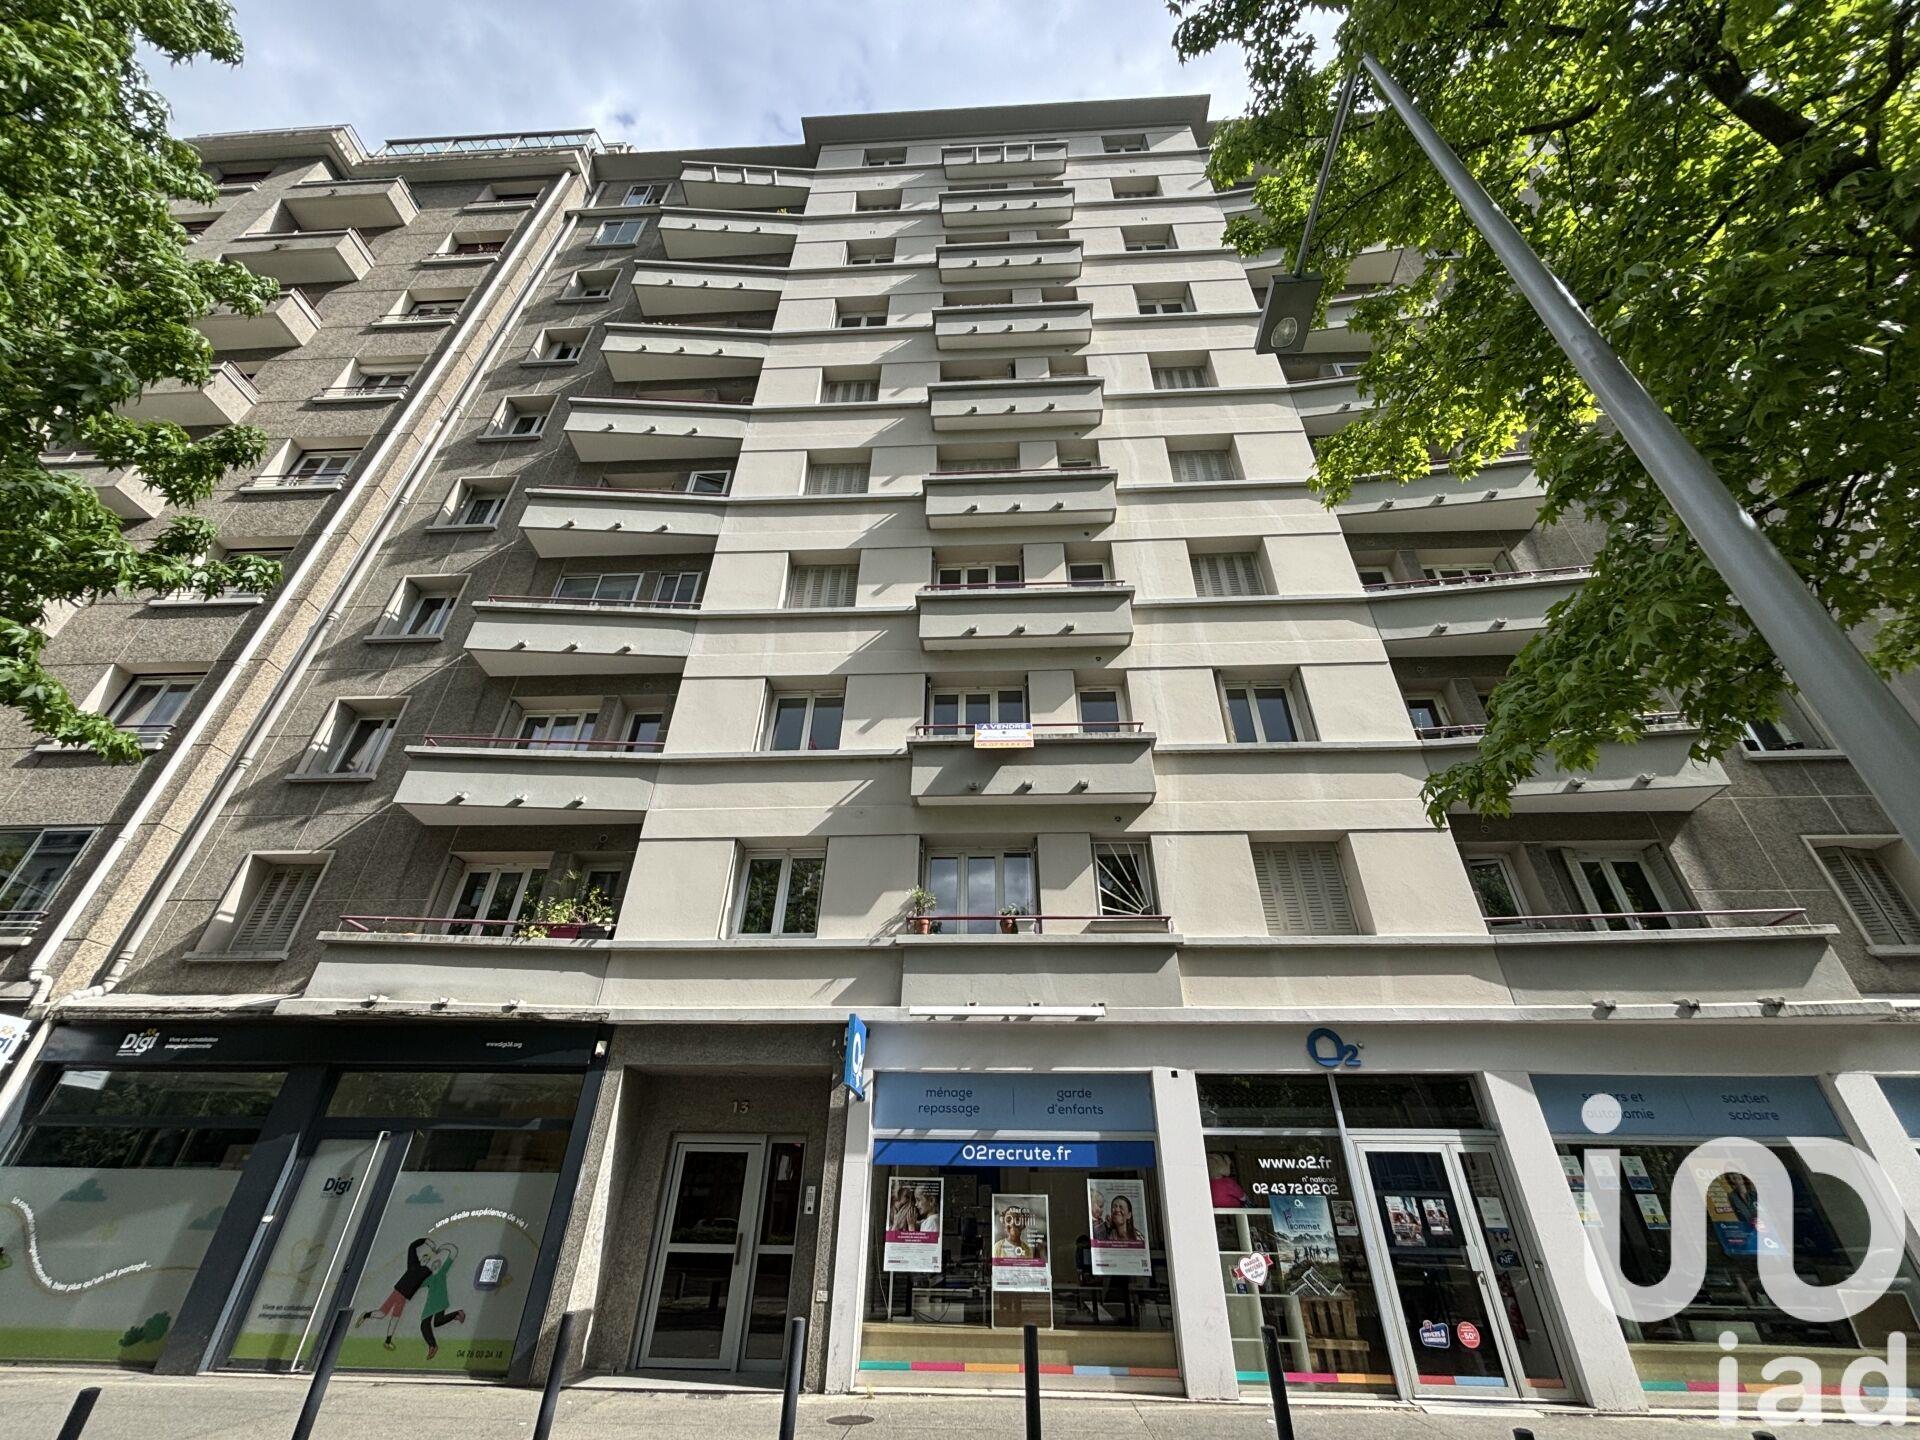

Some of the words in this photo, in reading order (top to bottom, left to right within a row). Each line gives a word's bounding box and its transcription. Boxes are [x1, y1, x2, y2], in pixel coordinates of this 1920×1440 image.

[120, 1032, 160, 1053] Digi
[926, 1087, 973, 1101] ménage
[1056, 1088, 1092, 1102] garde
[1630, 1093, 1646, 1103] et
[1721, 1092, 1770, 1104] soutien
[733, 1101, 748, 1114] 13
[918, 1103, 980, 1117] repassage
[1047, 1103, 1104, 1115] d'enfants
[1728, 1109, 1780, 1121] scolaire
[962, 1144, 1072, 1161] O2recrute.fr
[1258, 1156, 1332, 1169] www.o2.fr
[322, 1177, 354, 1195] Digi
[1252, 1183, 1269, 1194] 02
[1270, 1183, 1287, 1194] 43
[1287, 1183, 1304, 1194] 72
[1304, 1184, 1321, 1195] 02
[1322, 1184, 1339, 1195] 02
